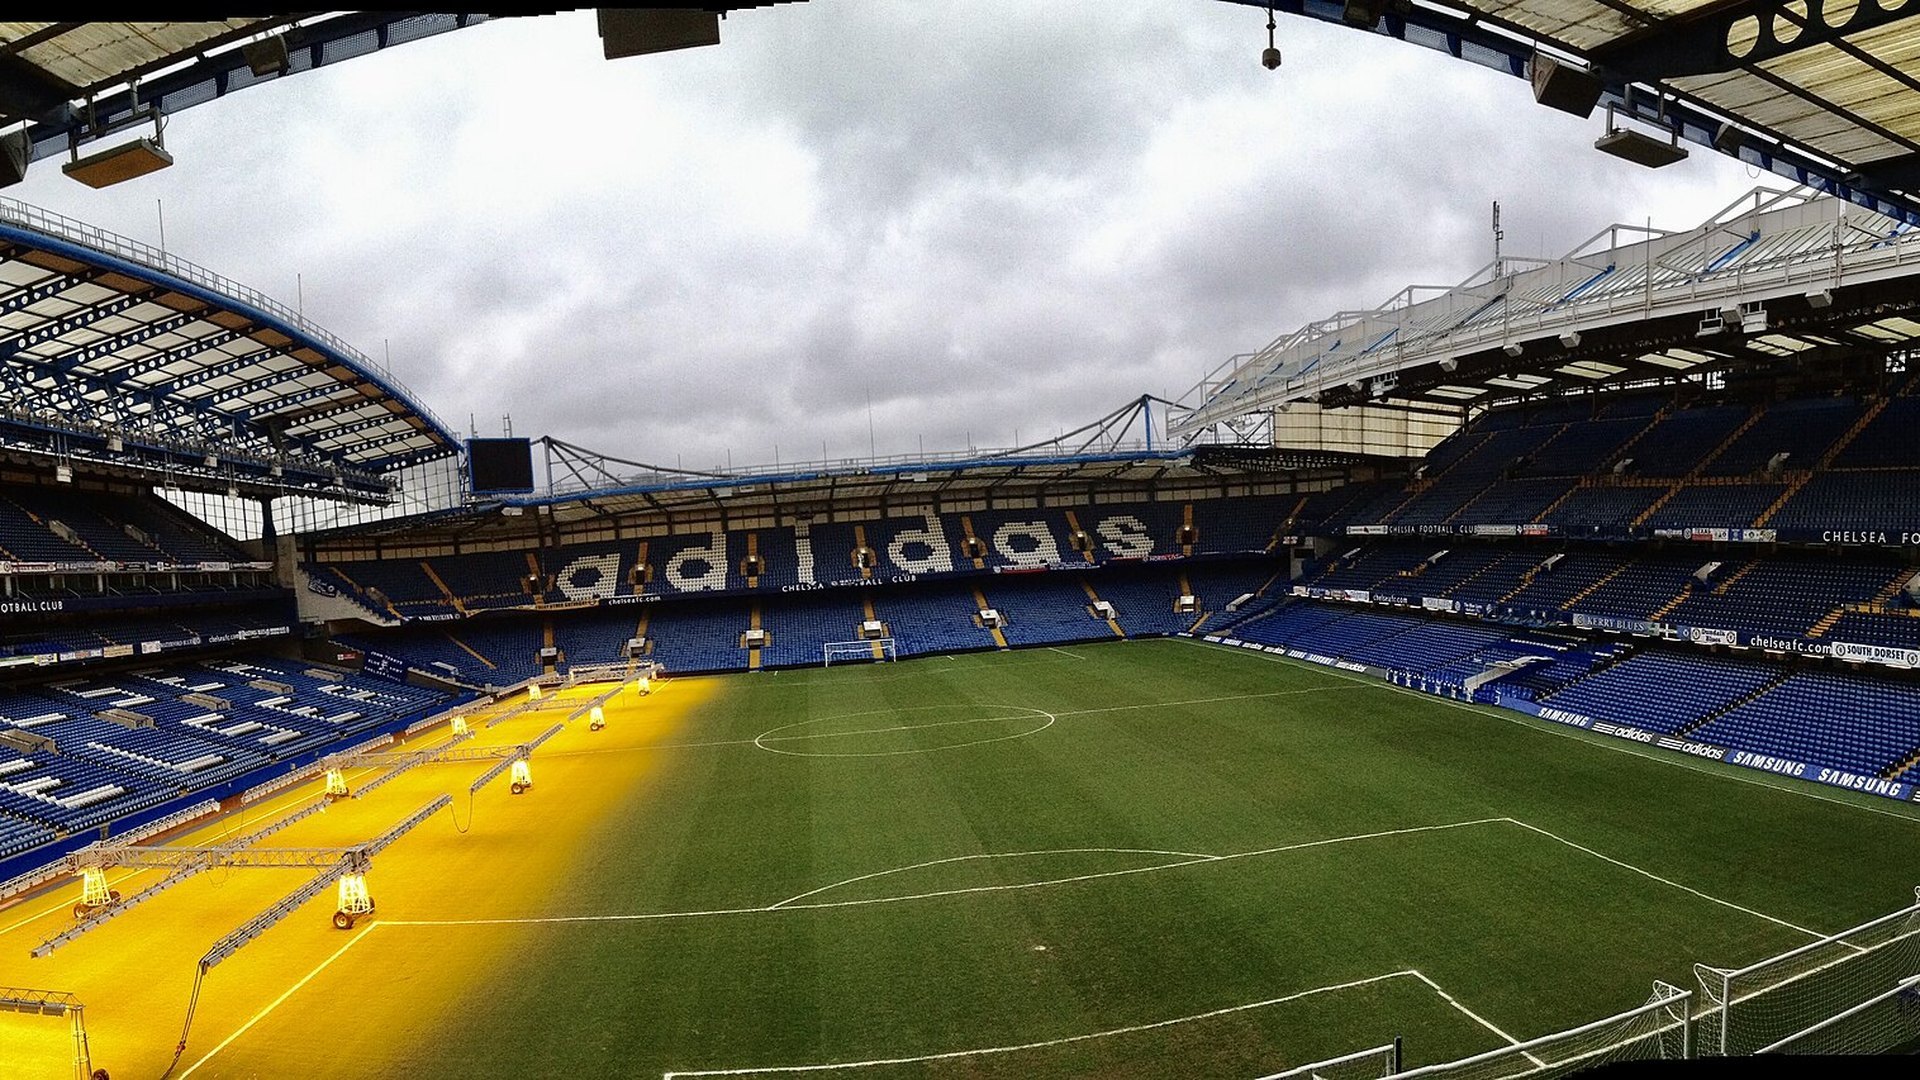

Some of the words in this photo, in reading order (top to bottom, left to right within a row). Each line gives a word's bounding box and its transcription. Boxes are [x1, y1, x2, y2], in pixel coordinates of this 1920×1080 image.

[1389, 525, 1416, 534] CHELSEA
[1419, 525, 1454, 534] FOOTBALL
[1822, 530, 1887, 544] CHELSEA
[557, 505, 1154, 603] adidas
[892, 574, 917, 583] CLUB
[0, 602, 38, 613] OTBALL
[40, 600, 63, 611] CLUB
[1586, 616, 1615, 628] KERRY
[1616, 620, 1645, 632] BLUES
[1750, 635, 1832, 655] chelseafc.com
[1847, 645, 1872, 657] SOUTH
[1874, 647, 1905, 661] DORSET
[1537, 707, 1590, 727] SAMSUNG
[1615, 726, 1655, 744] adidas
[1682, 742, 1726, 761] adidas
[1733, 751, 1806, 777] SAMSUNG
[1818, 768, 1902, 797] SAMSUNG
